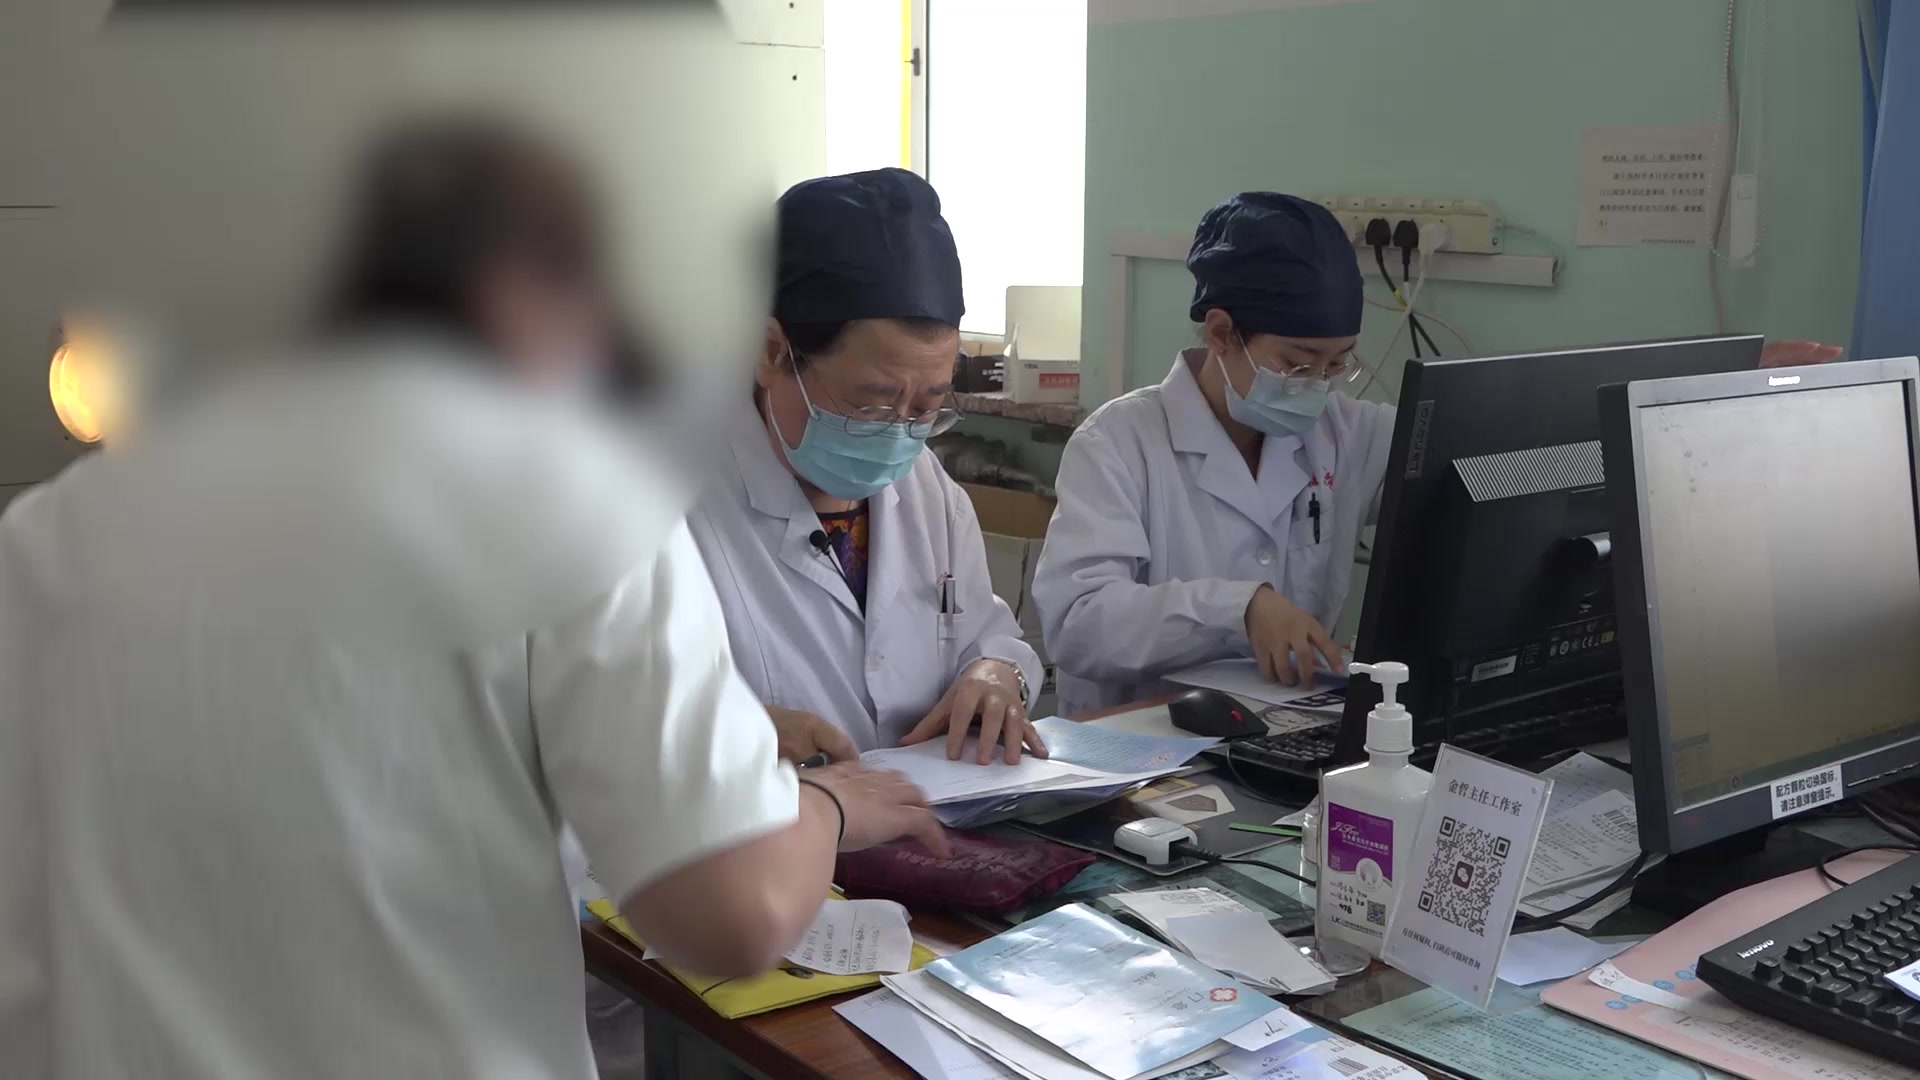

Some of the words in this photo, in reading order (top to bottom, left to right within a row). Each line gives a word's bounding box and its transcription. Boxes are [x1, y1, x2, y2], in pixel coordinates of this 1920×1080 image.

[1448, 778, 1523, 817] 金哲主任工作室
[1737, 939, 1775, 959] lenovo
